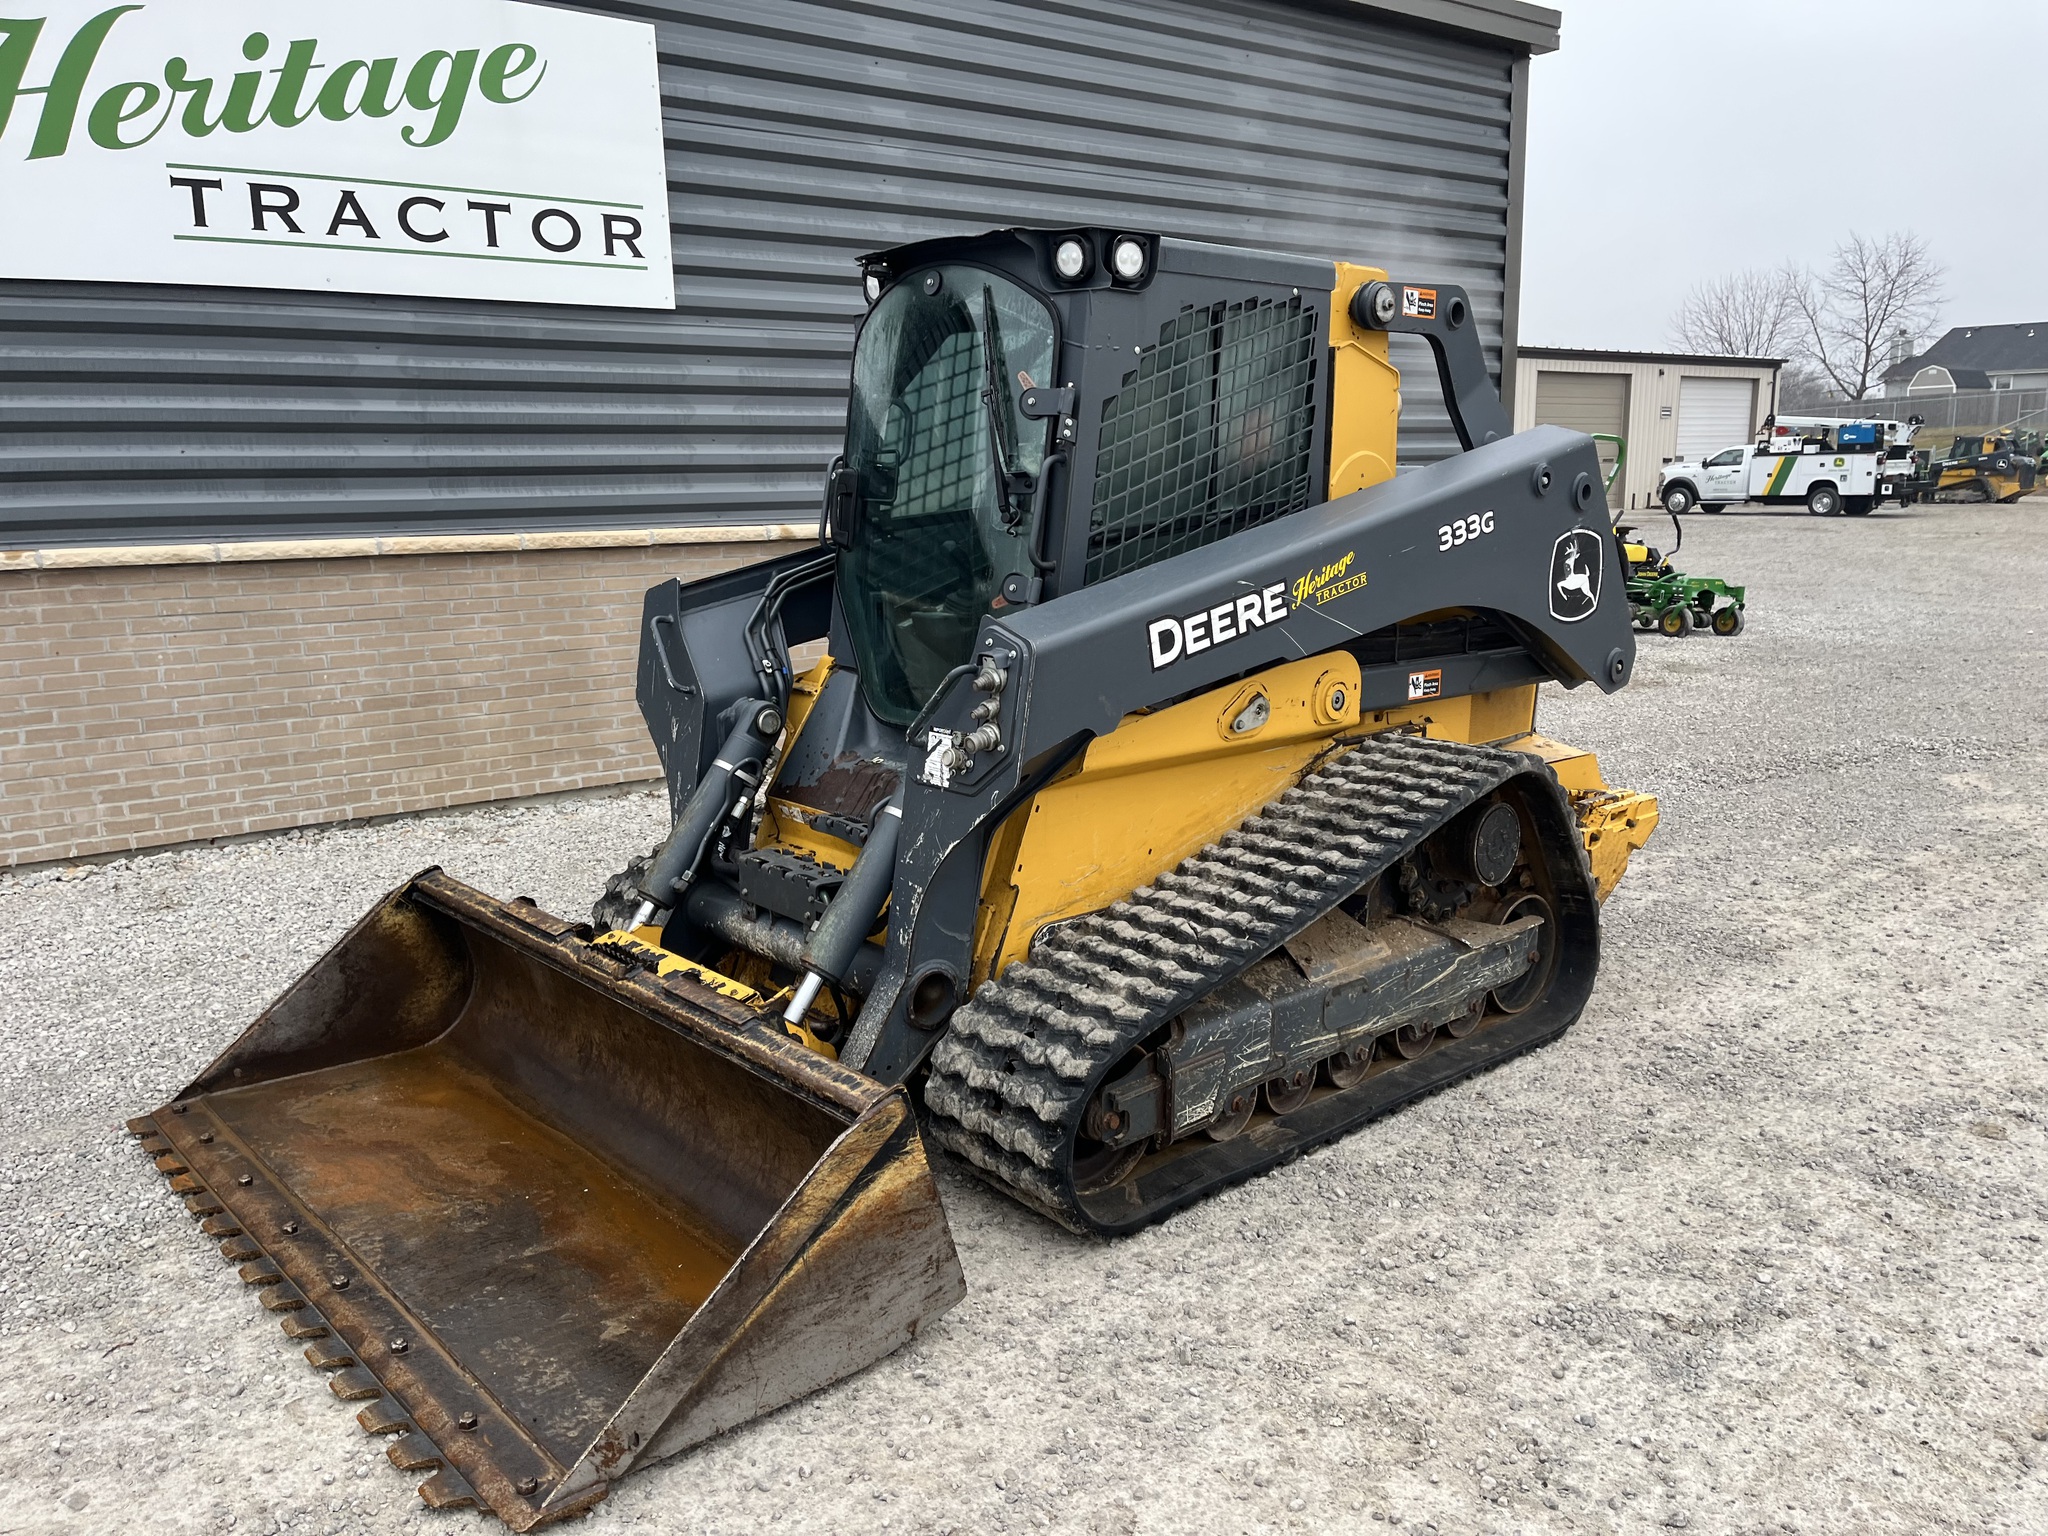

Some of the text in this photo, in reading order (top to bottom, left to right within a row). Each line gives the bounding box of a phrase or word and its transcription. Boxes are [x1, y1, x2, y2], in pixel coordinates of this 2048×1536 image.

[0, 4, 547, 160] Heritage
[169, 174, 646, 259] TRACTOR
[1438, 510, 1495, 552] 333G
[1292, 551, 1355, 610] Heritage
[1316, 574, 1367, 603] TRACTOR
[1149, 582, 1288, 669] DEERE
